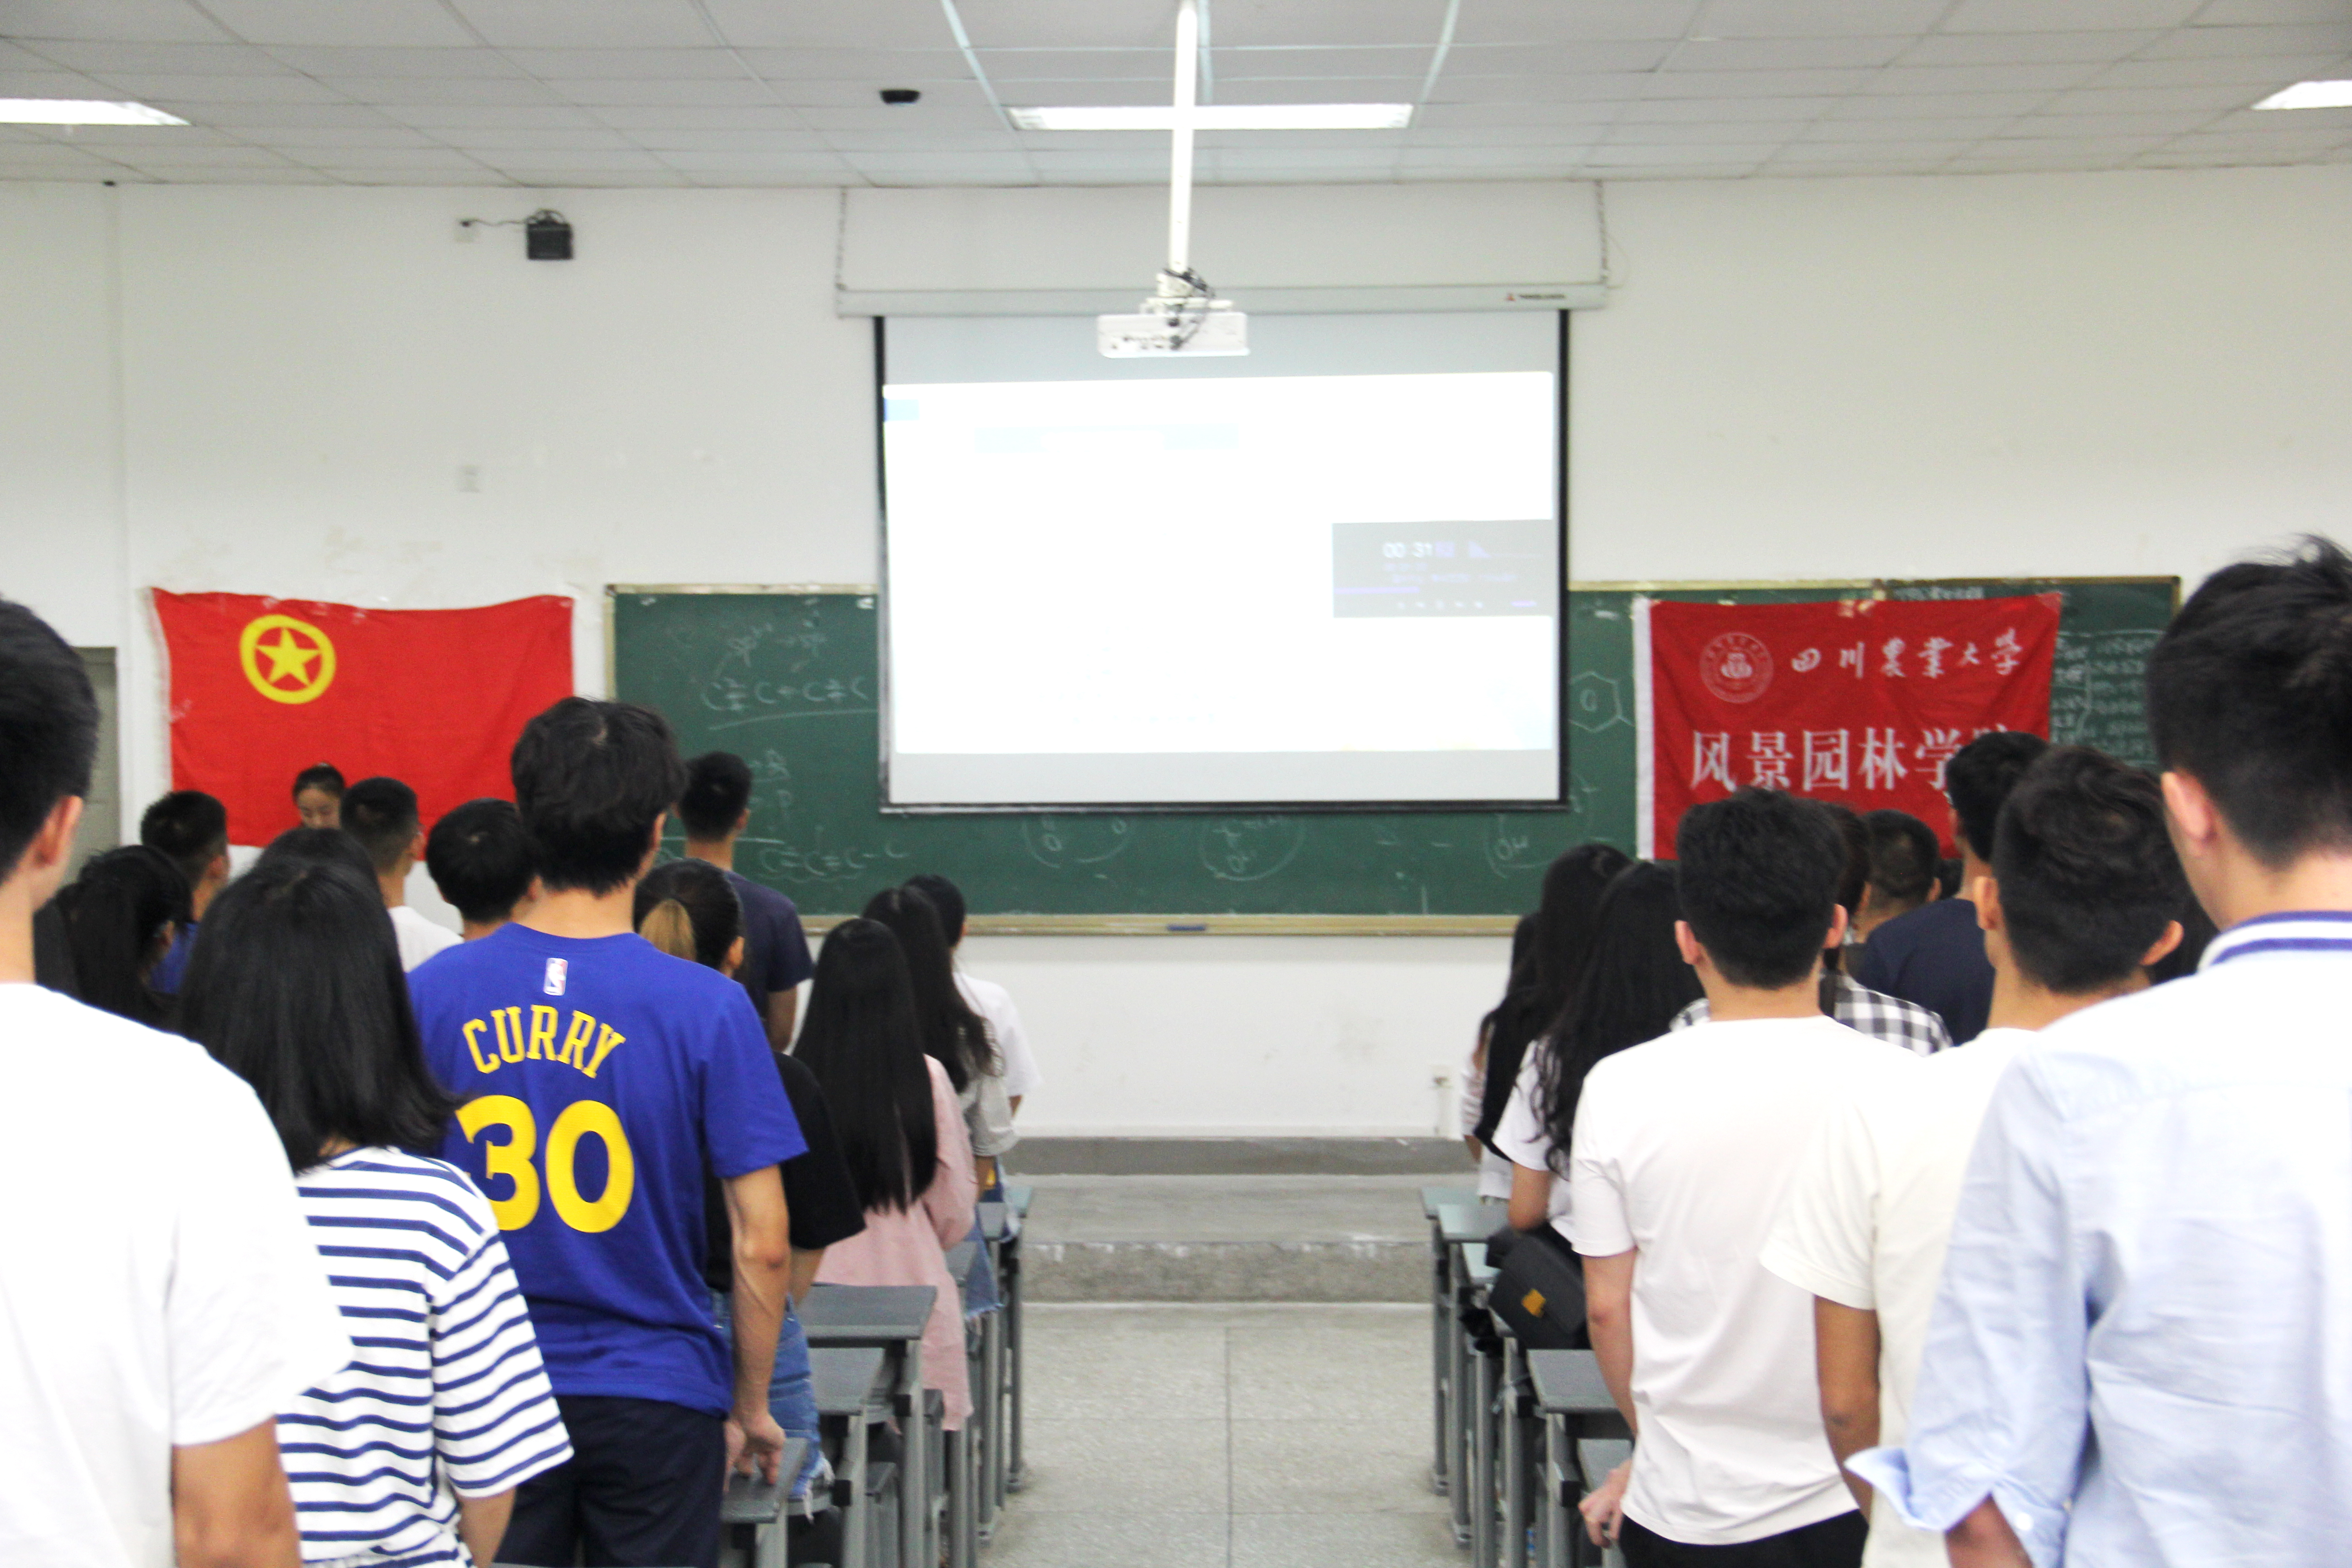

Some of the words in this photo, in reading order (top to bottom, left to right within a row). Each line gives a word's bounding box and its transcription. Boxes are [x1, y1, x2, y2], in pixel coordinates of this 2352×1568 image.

[1690, 724, 2009, 792] 风景园林学
[462, 1004, 626, 1079] CURRY
[455, 1094, 635, 1233] 30
